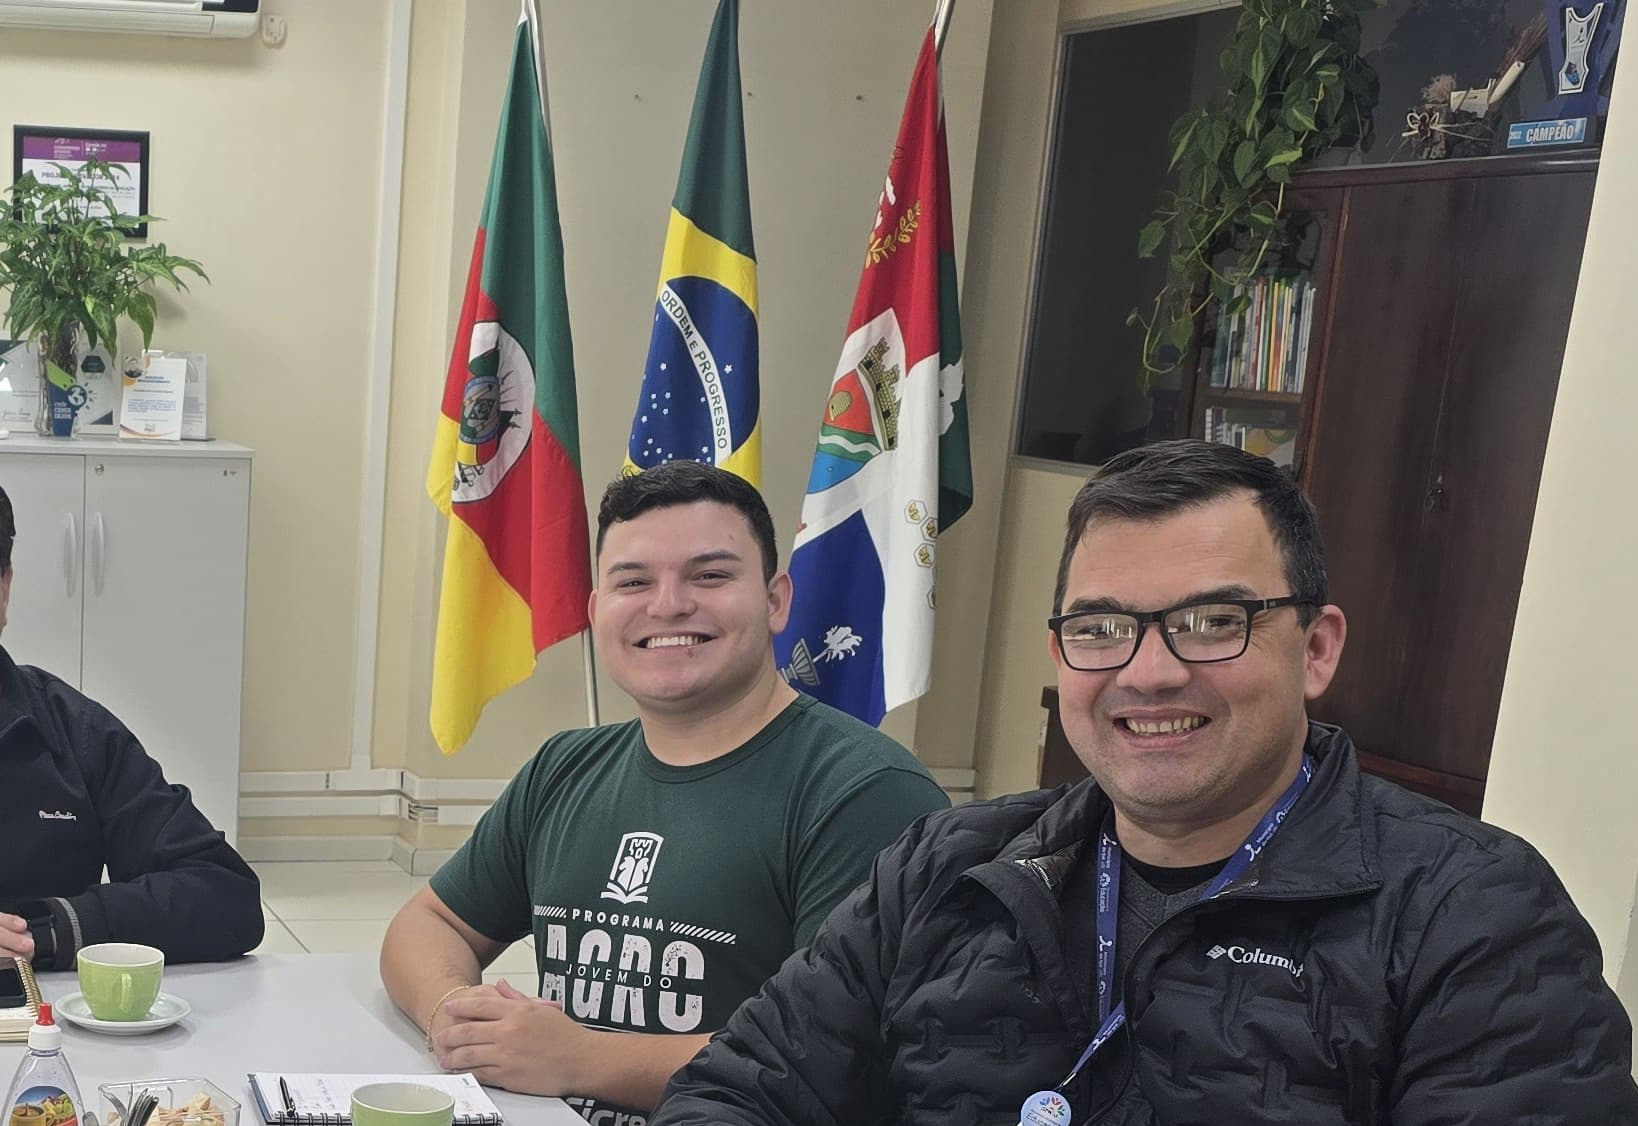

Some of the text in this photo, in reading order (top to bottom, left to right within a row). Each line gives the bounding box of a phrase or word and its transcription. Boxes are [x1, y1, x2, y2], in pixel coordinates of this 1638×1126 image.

[662, 290, 728, 449] ORDEM E PROGRESSO
[573, 909, 663, 932] PROGRAMA
[566, 963, 672, 989] JOVEM DO
